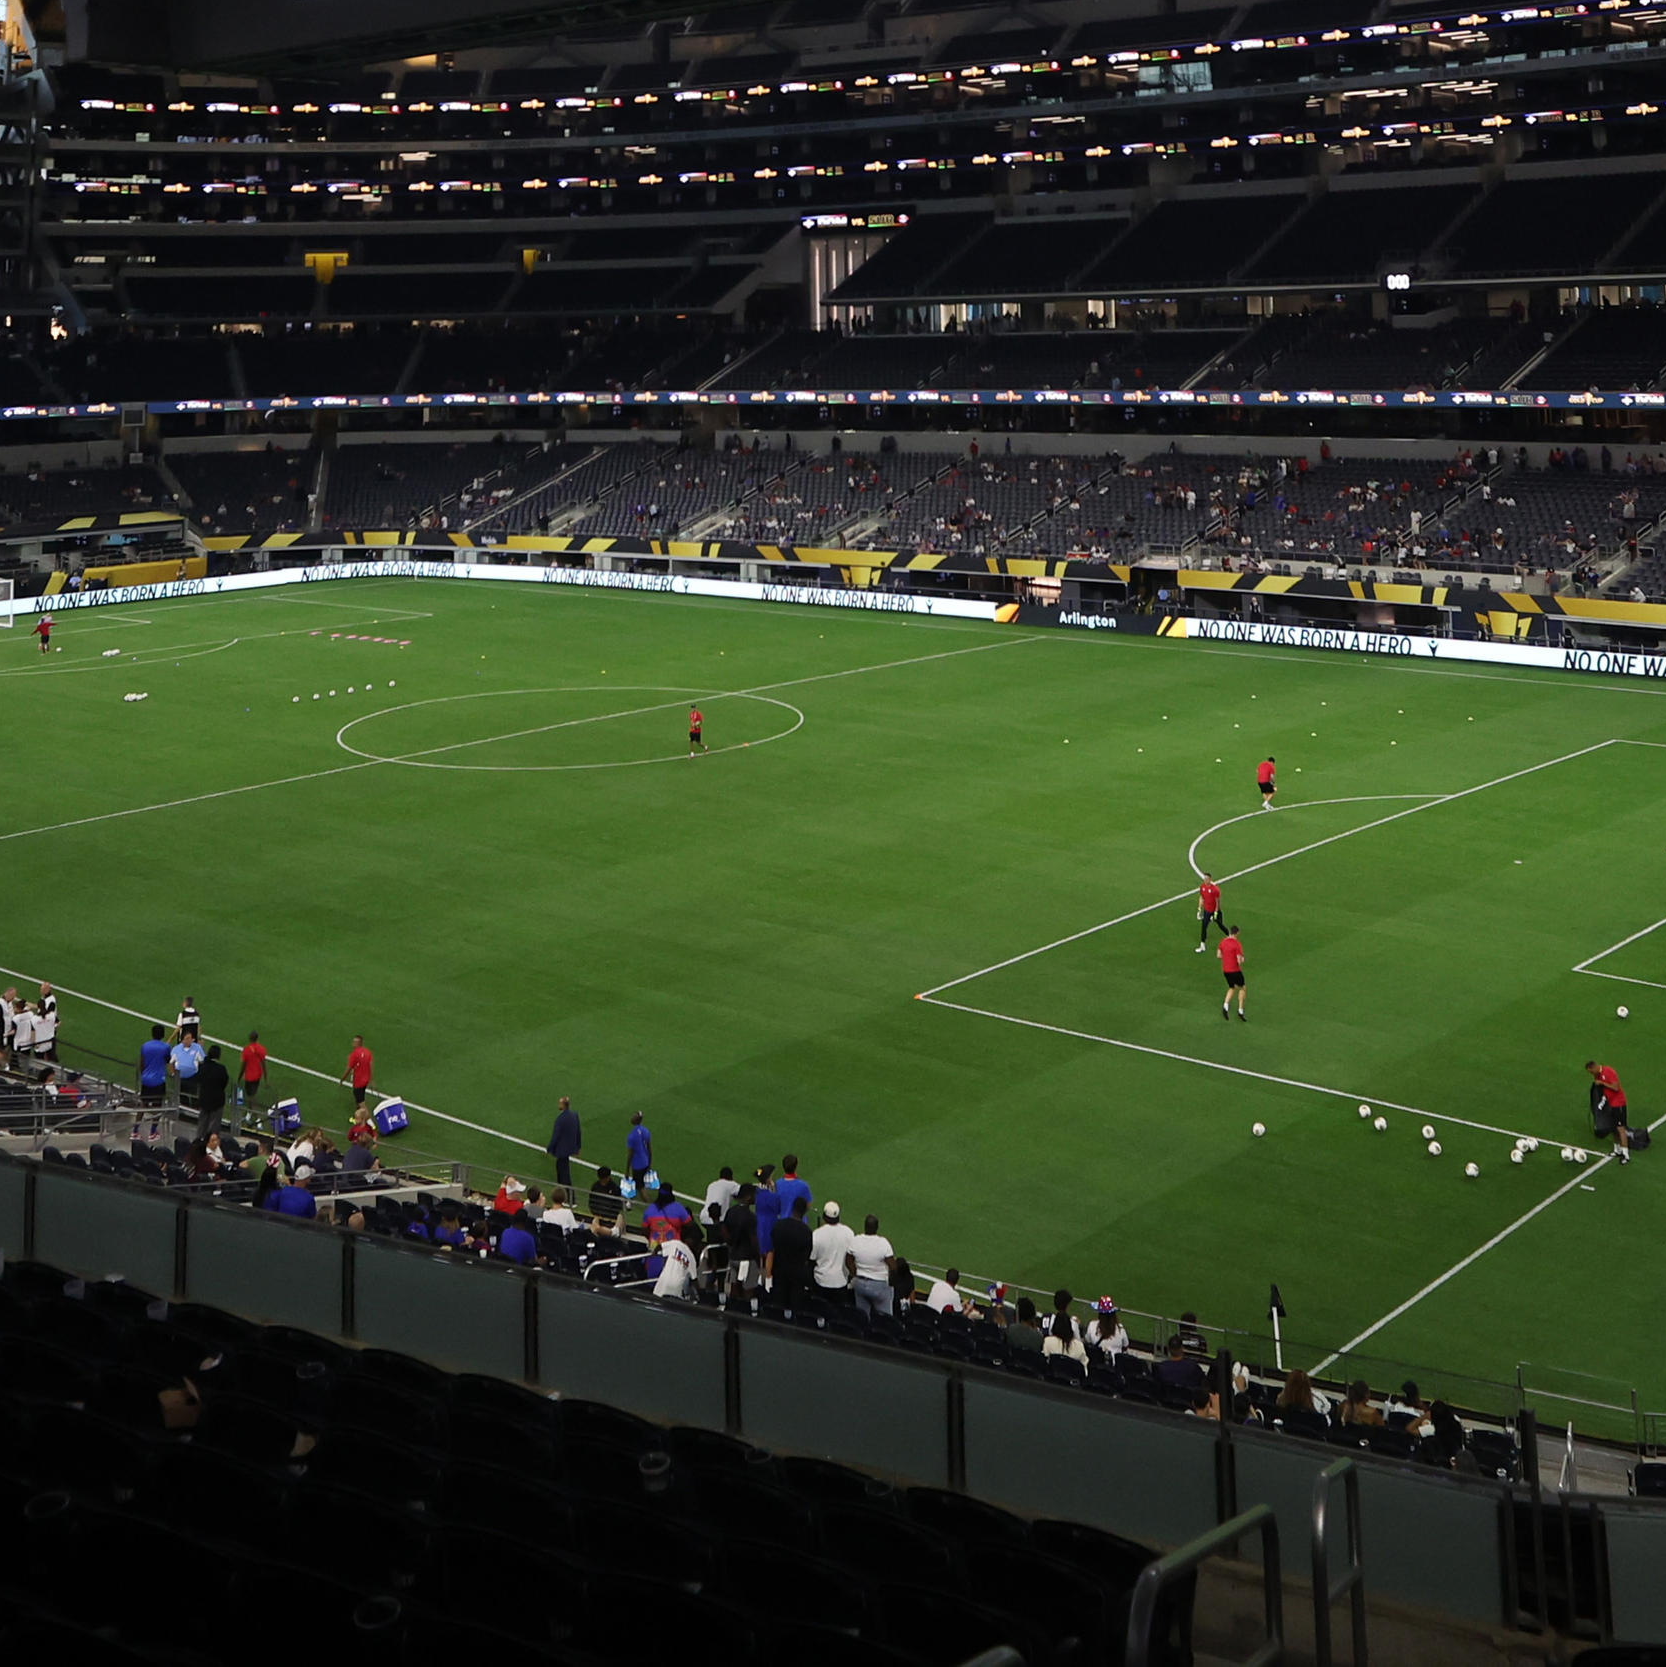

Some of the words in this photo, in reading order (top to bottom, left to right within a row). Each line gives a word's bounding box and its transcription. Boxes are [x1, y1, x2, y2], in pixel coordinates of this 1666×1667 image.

[34, 596, 54, 612] NO
[58, 592, 84, 609] ONE
[89, 588, 117, 606] WAS
[121, 584, 158, 603] BORN
[161, 583, 167, 598] A
[761, 585, 778, 601] NO
[781, 585, 805, 603] ONE
[807, 587, 831, 606] WAS
[835, 589, 867, 609] BORN
[871, 593, 878, 610] A
[1059, 611, 1117, 629] Arlington
[1198, 620, 1218, 639] NO
[1223, 621, 1257, 642] ONE
[1261, 624, 1296, 646] WAS
[1301, 627, 1347, 649] BORN
[1351, 631, 1361, 651] A
[1564, 650, 1591, 670] NO
[1596, 652, 1638, 675] ONE
